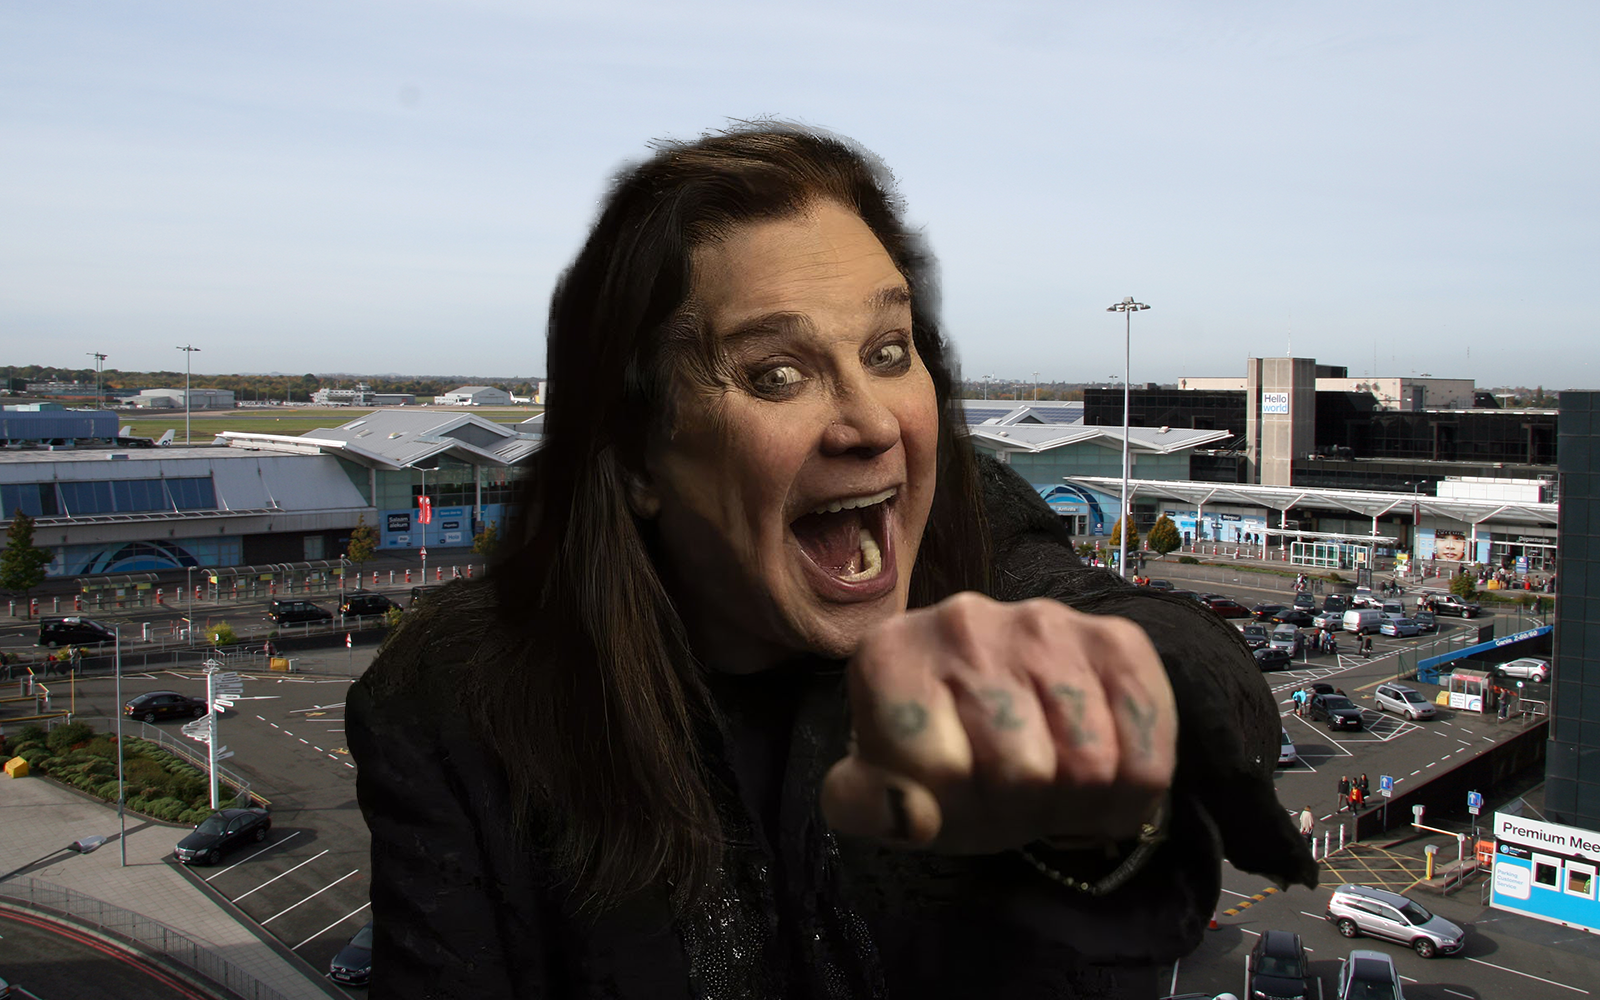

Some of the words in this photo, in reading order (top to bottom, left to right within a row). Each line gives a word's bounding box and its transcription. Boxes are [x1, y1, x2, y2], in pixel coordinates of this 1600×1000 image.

[1264, 394, 1287, 403] Hello
[1263, 404, 1287, 412] world
[1503, 822, 1565, 845] Premium
[1497, 869, 1518, 879] Parking
[1496, 874, 1524, 885] Customer
[1496, 881, 1517, 890] Service
